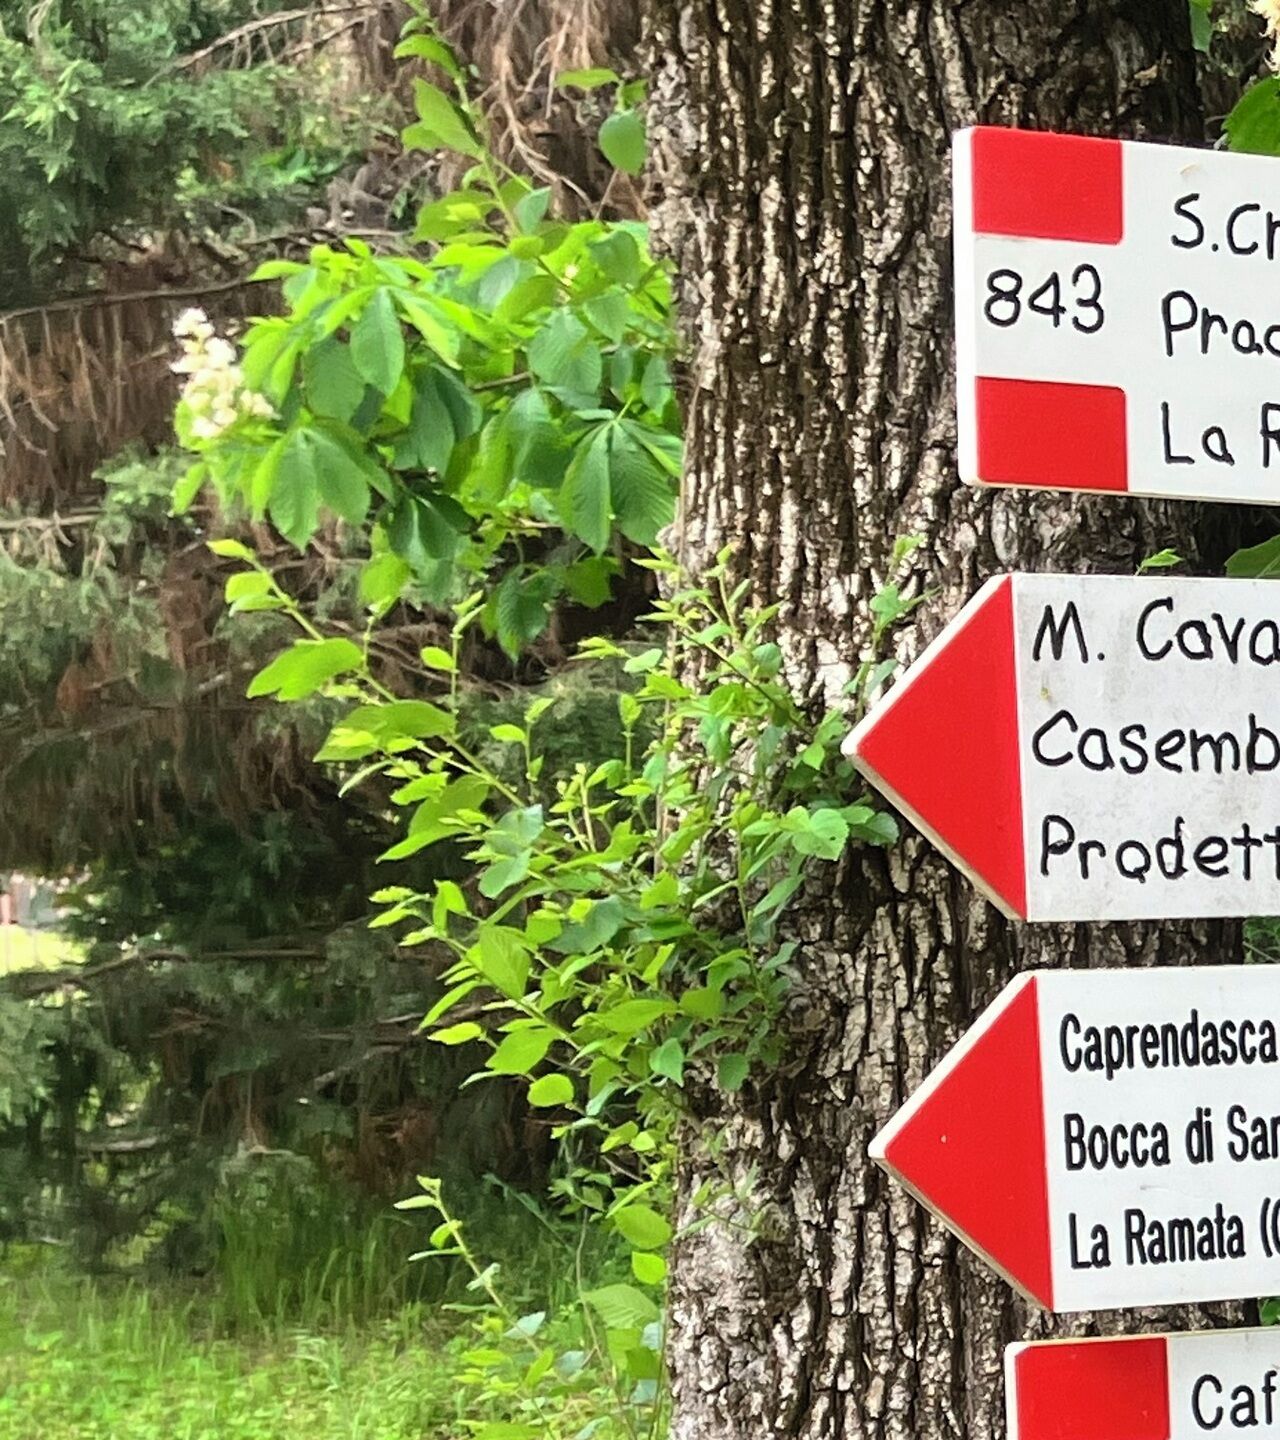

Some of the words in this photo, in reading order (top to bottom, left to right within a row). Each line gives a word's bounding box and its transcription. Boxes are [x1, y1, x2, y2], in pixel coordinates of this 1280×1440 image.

[984, 263, 1105, 334] 843
[1161, 401, 1235, 466] La
[1032, 600, 1105, 664] M.
[1059, 1008, 1279, 1081] Caprendasca
[1064, 1113, 1171, 1171] Bocca
[1185, 1106, 1214, 1165] di
[1069, 1212, 1112, 1270] La
[1124, 1202, 1247, 1266] Ramata
